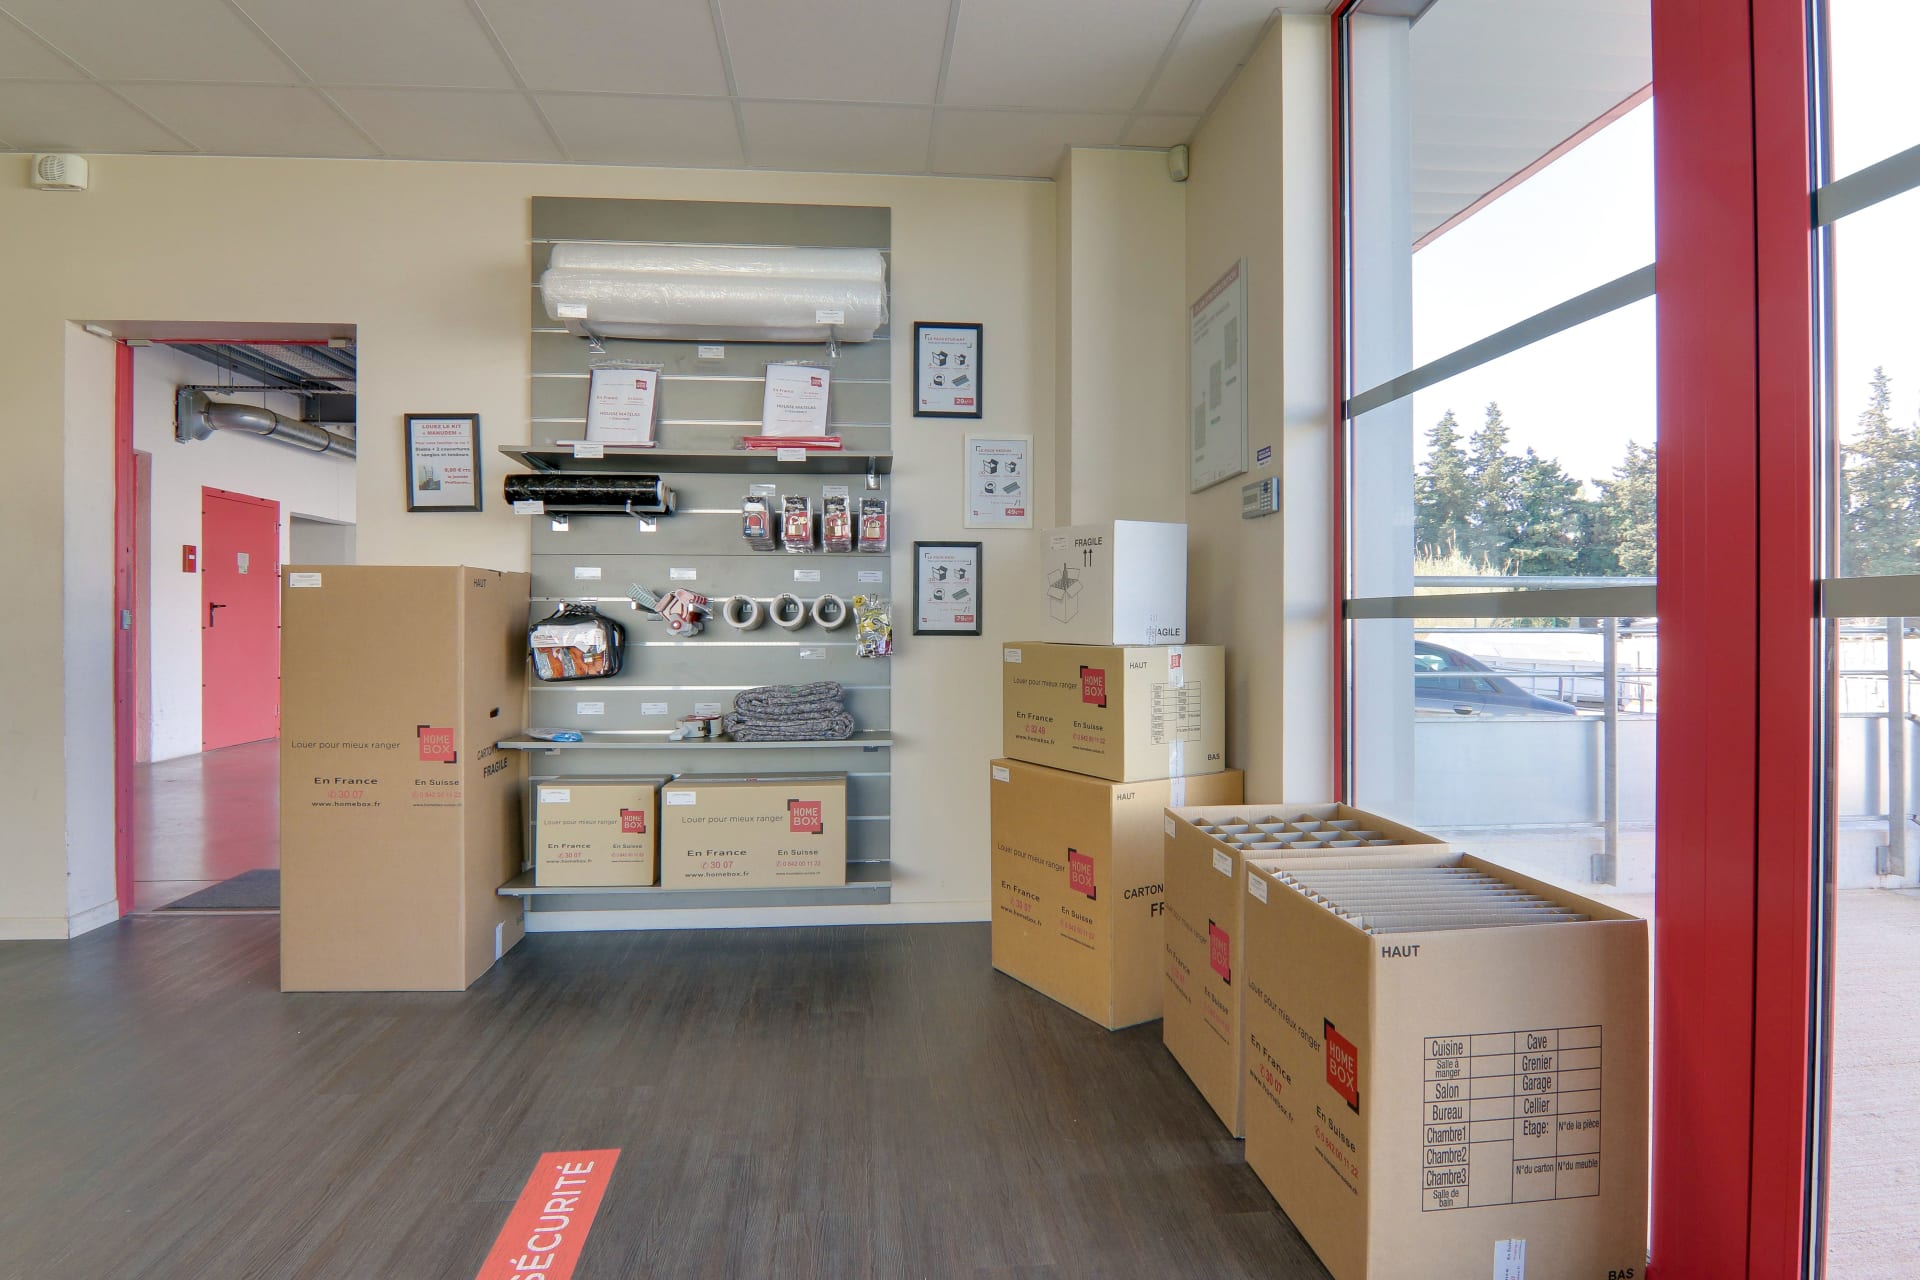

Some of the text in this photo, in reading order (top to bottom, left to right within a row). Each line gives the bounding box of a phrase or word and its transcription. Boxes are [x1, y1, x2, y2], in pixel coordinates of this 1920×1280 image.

[1075, 537, 1103, 547] FRAGILE
[473, 579, 486, 587] HAUT
[1157, 627, 1181, 637] AGILE
[1084, 675, 1103, 686] HOME
[1085, 687, 1103, 697] BOX
[1016, 711, 1054, 723] En France
[1083, 722, 1104, 731] Suisse
[291, 740, 400, 750] Louer pour mieux ranger
[423, 735, 450, 744] HOME
[423, 745, 450, 754] BOX
[484, 756, 508, 779] FRAGILE
[314, 777, 379, 785] En France
[1117, 792, 1135, 800] HAUT
[793, 807, 818, 817] HOME
[624, 821, 642, 829] BOX
[682, 816, 705, 824] Louer
[729, 815, 754, 823] mieux
[756, 815, 784, 823] ranger
[793, 817, 818, 826] BOX
[687, 849, 747, 857] En France
[711, 861, 734, 869] 30 07
[1072, 861, 1091, 876] HOME
[1072, 871, 1092, 887] BOX
[1001, 880, 1040, 902] En France
[1123, 883, 1164, 900] CARTON
[1061, 906, 1093, 925] En Suisse
[1381, 944, 1420, 958] HAUT
[1248, 976, 1321, 1053] Louer pour mieux ranger
[1432, 1039, 1463, 1056] Cuisine
[1527, 1033, 1547, 1050] Cave
[1250, 1033, 1292, 1086] En France
[1329, 1040, 1354, 1075] HOME
[1436, 1058, 1459, 1069] Salle à
[1522, 1054, 1552, 1071] Grenier
[1330, 1058, 1354, 1092] BOX
[1435, 1069, 1461, 1079] manger
[1522, 1075, 1552, 1093] Garage
[1435, 1082, 1460, 1099] Salon
[1523, 1097, 1550, 1114] Cellier
[1432, 1104, 1463, 1120] Bureau
[1316, 1105, 1326, 1122] En
[1328, 1118, 1356, 1153] Suisse
[1523, 1120, 1549, 1138] Etage:
[1575, 1120, 1582, 1130] la
[1582, 1119, 1599, 1131] pièce
[1427, 1125, 1466, 1143] Chambre1
[1426, 1146, 1467, 1165] Chambre2
[1533, 1163, 1554, 1173] carton
[1574, 1158, 1598, 1169] meuble
[1426, 1168, 1467, 1186] Chambre3
[1433, 1188, 1459, 1199] Salle de
[1439, 1198, 1453, 1208] bain
[1608, 1268, 1634, 1280] BAS
